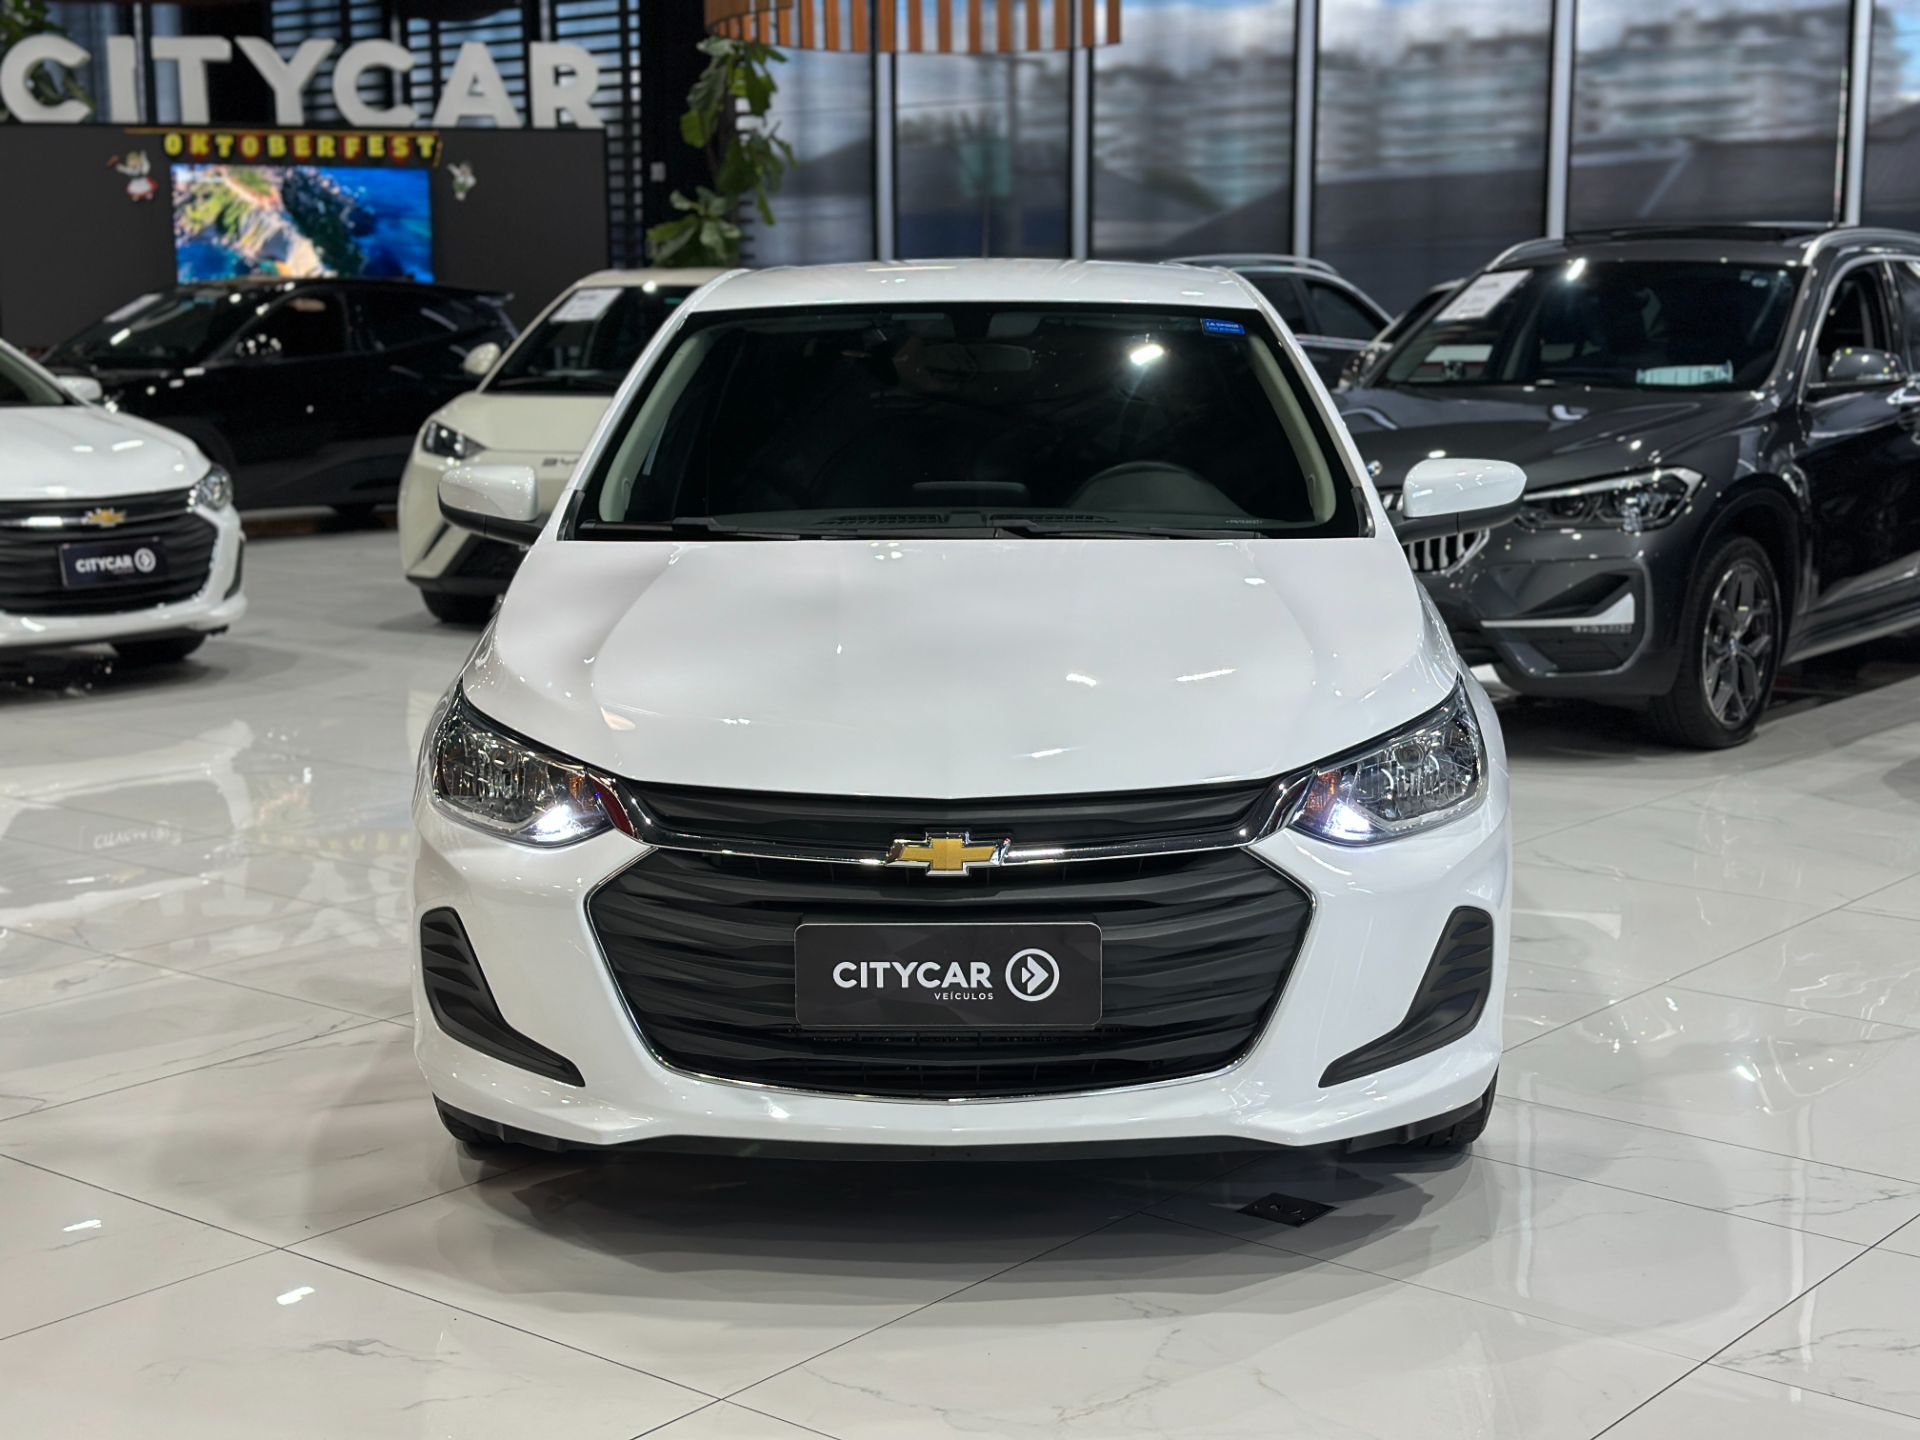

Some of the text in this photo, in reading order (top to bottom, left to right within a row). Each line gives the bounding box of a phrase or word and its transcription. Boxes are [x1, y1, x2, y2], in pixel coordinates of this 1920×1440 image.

[0, 34, 606, 129] CITYCAR
[164, 132, 436, 159] OKTOBERFEST
[75, 555, 133, 573] CITYCAR
[832, 961, 993, 988] CITYCAR
[934, 991, 994, 1000] VEÍCULOS
